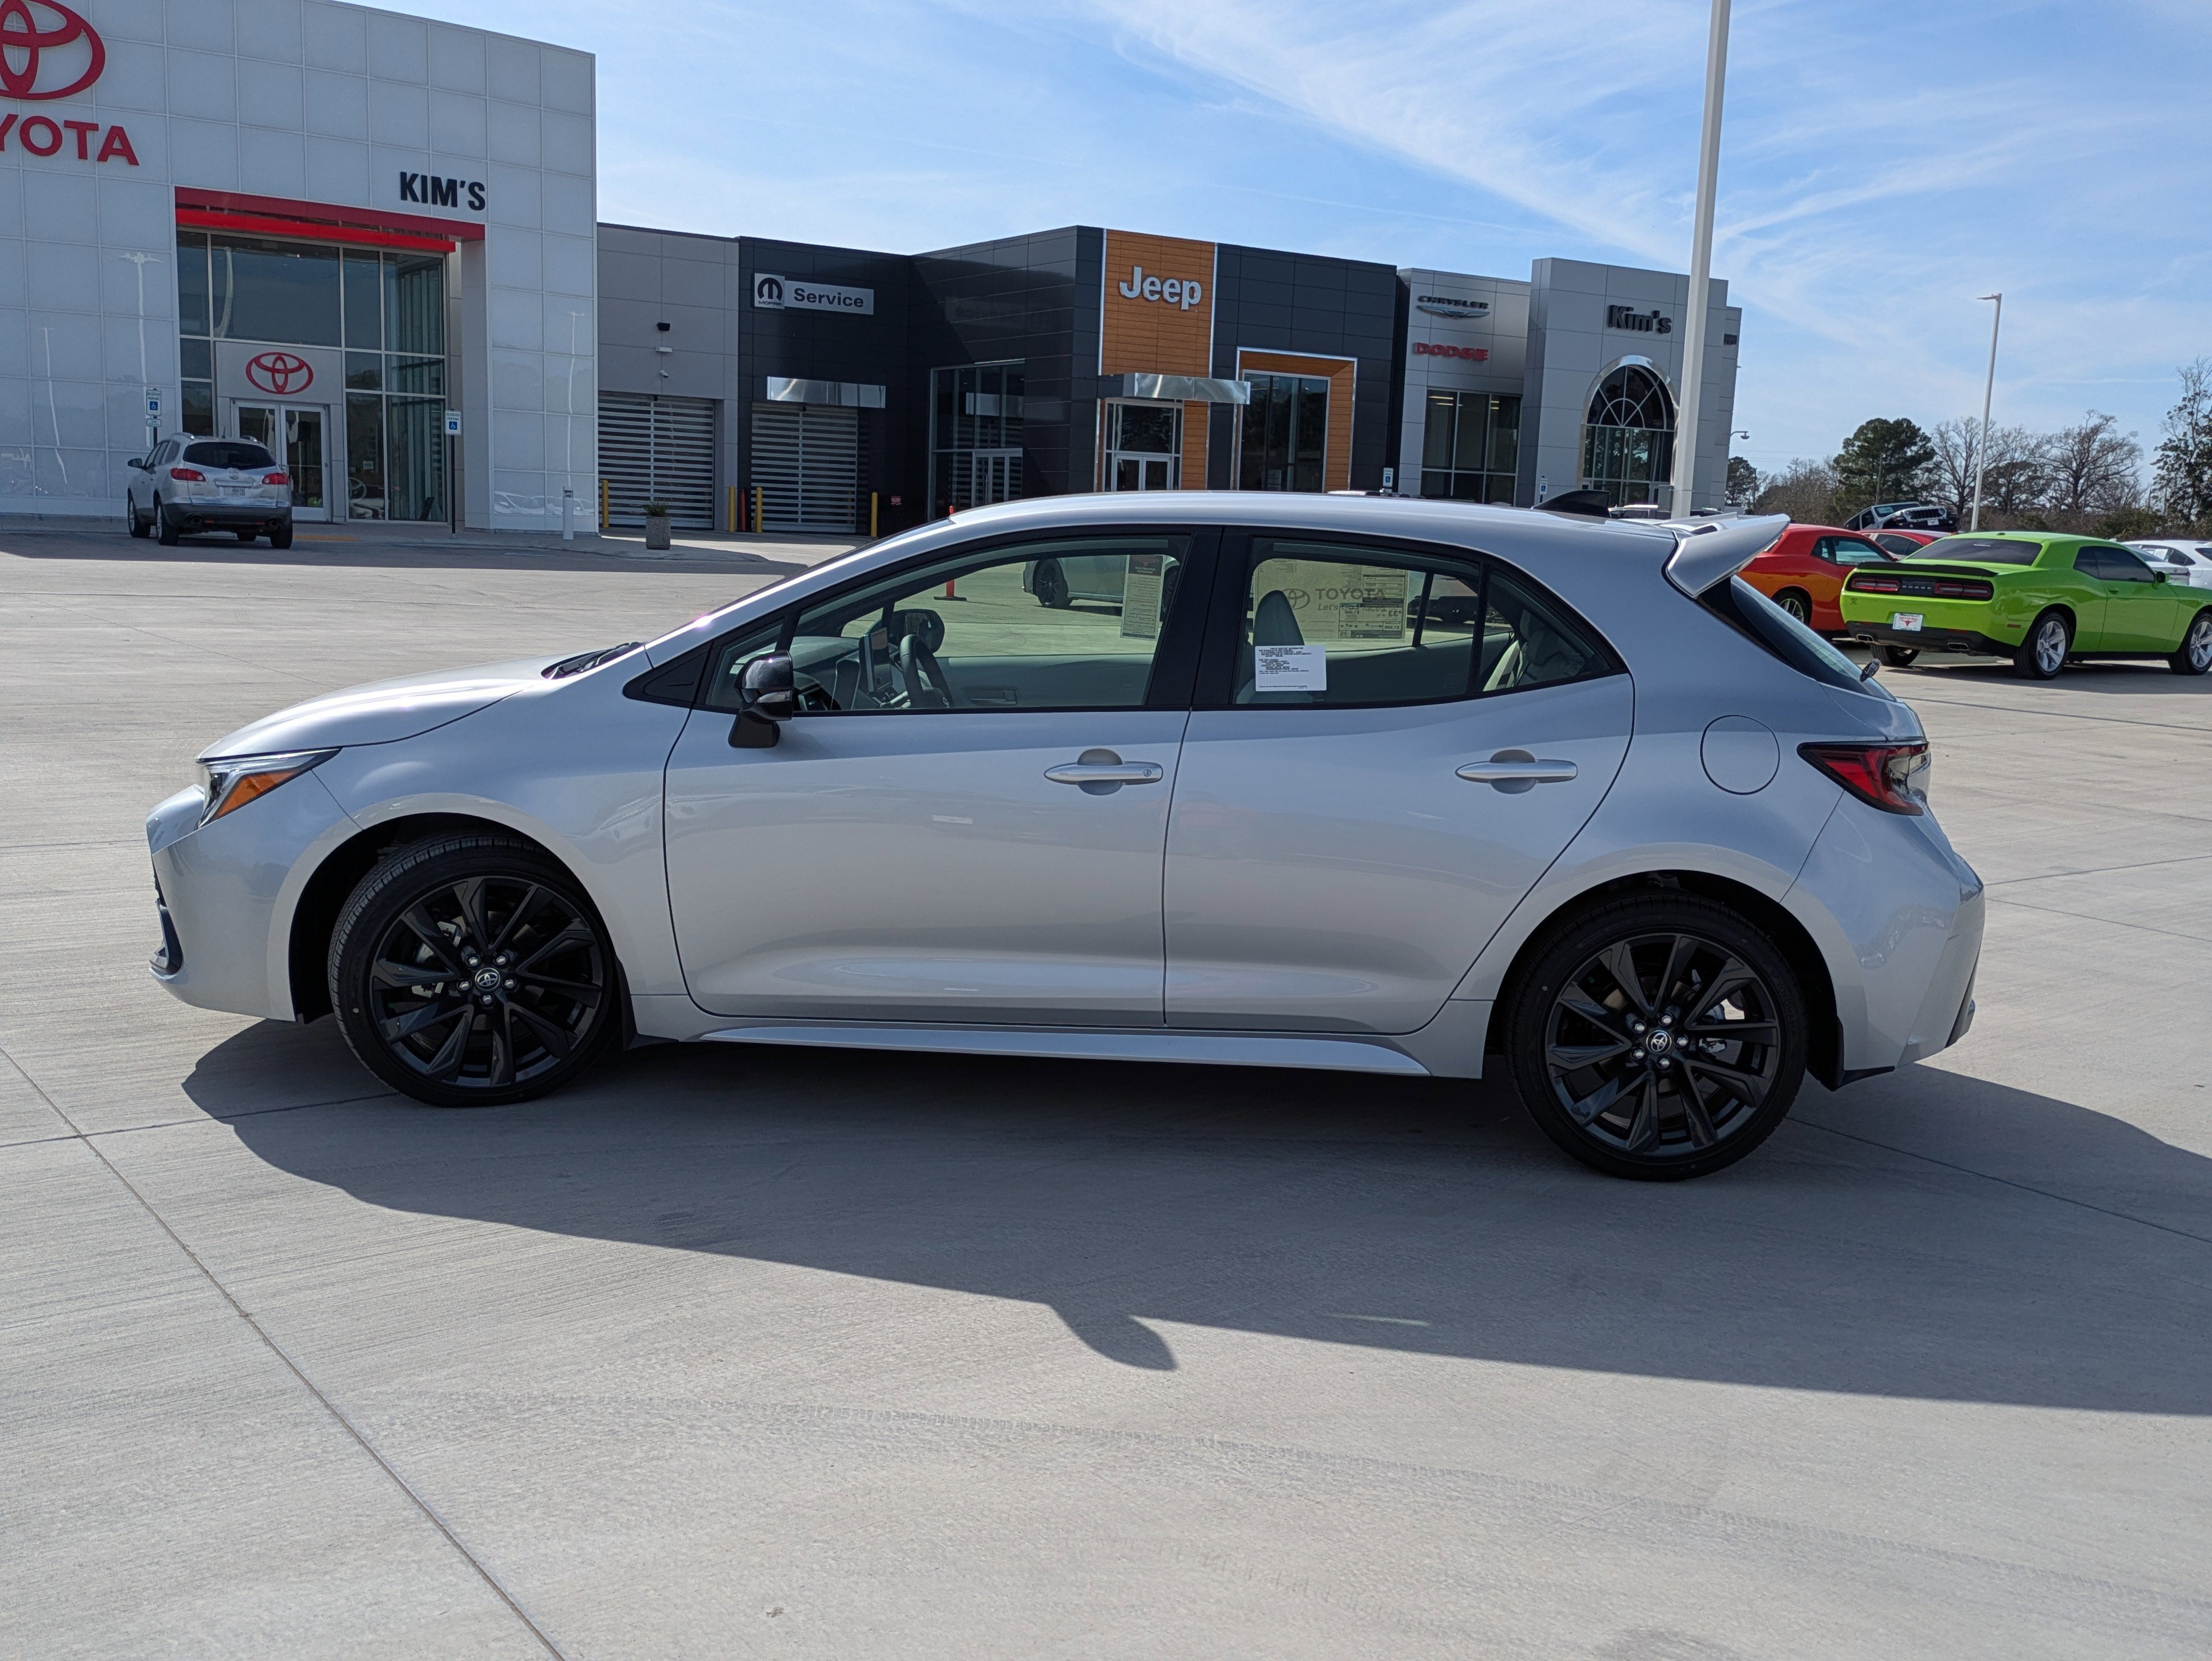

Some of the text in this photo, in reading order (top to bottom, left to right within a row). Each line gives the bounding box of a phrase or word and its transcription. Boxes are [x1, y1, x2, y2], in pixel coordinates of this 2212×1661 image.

[400, 171, 486, 211] KIM'S
[794, 288, 864, 308] Service
[1119, 266, 1202, 311] Jeep
[1417, 295, 1489, 310] CHRYSLER
[1607, 305, 1672, 334] Kim's
[1415, 342, 1489, 361] DODGE
